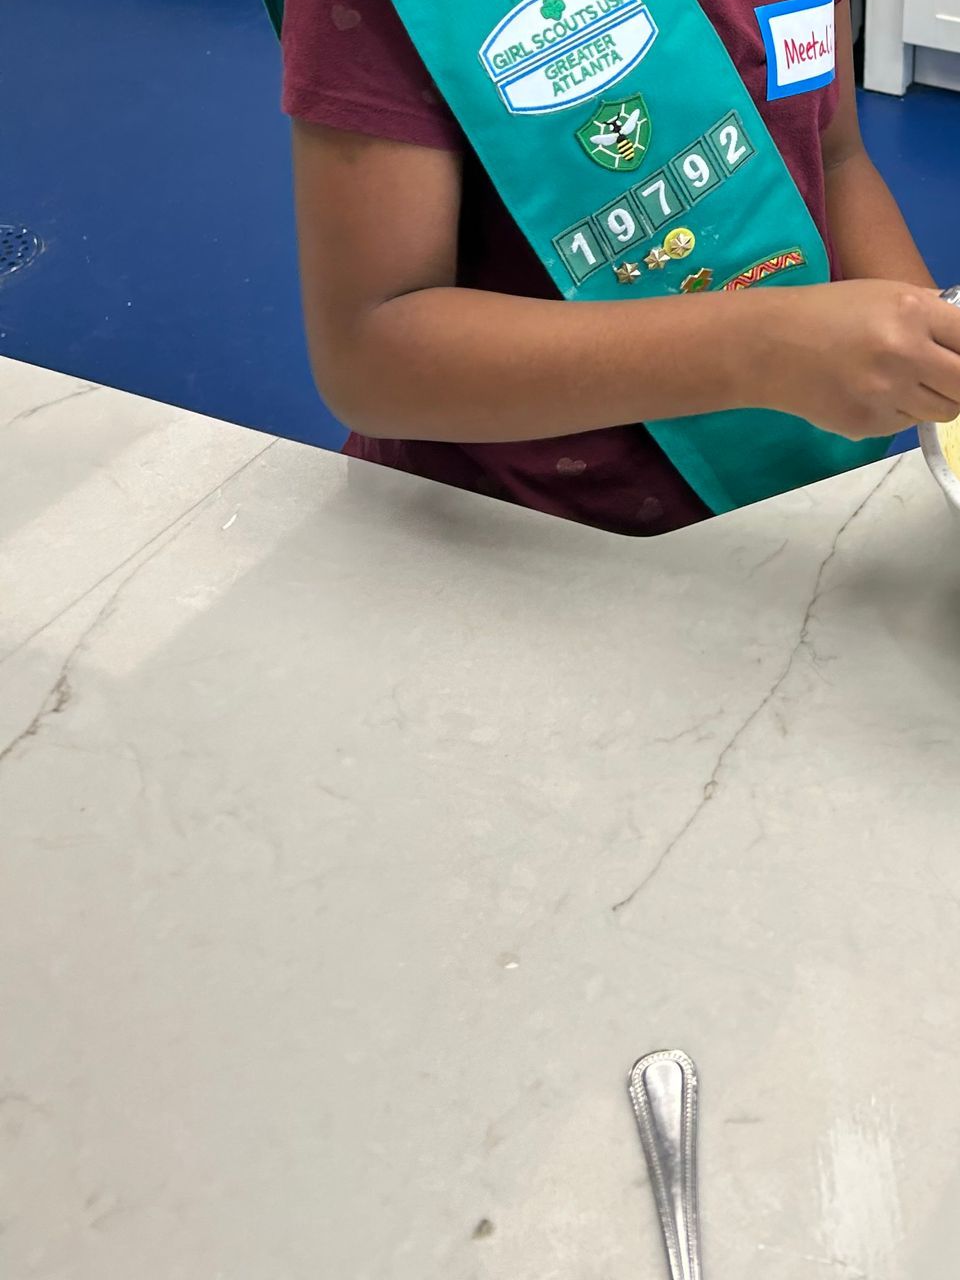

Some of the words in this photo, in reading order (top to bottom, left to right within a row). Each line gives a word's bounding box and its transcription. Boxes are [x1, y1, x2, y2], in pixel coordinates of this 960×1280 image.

[492, 41, 534, 70] GIRL
[531, 4, 599, 51] SCOUTS
[544, 33, 617, 81] GREATER
[551, 49, 624, 97] ATLANTA
[571, 125, 747, 266] 19792
